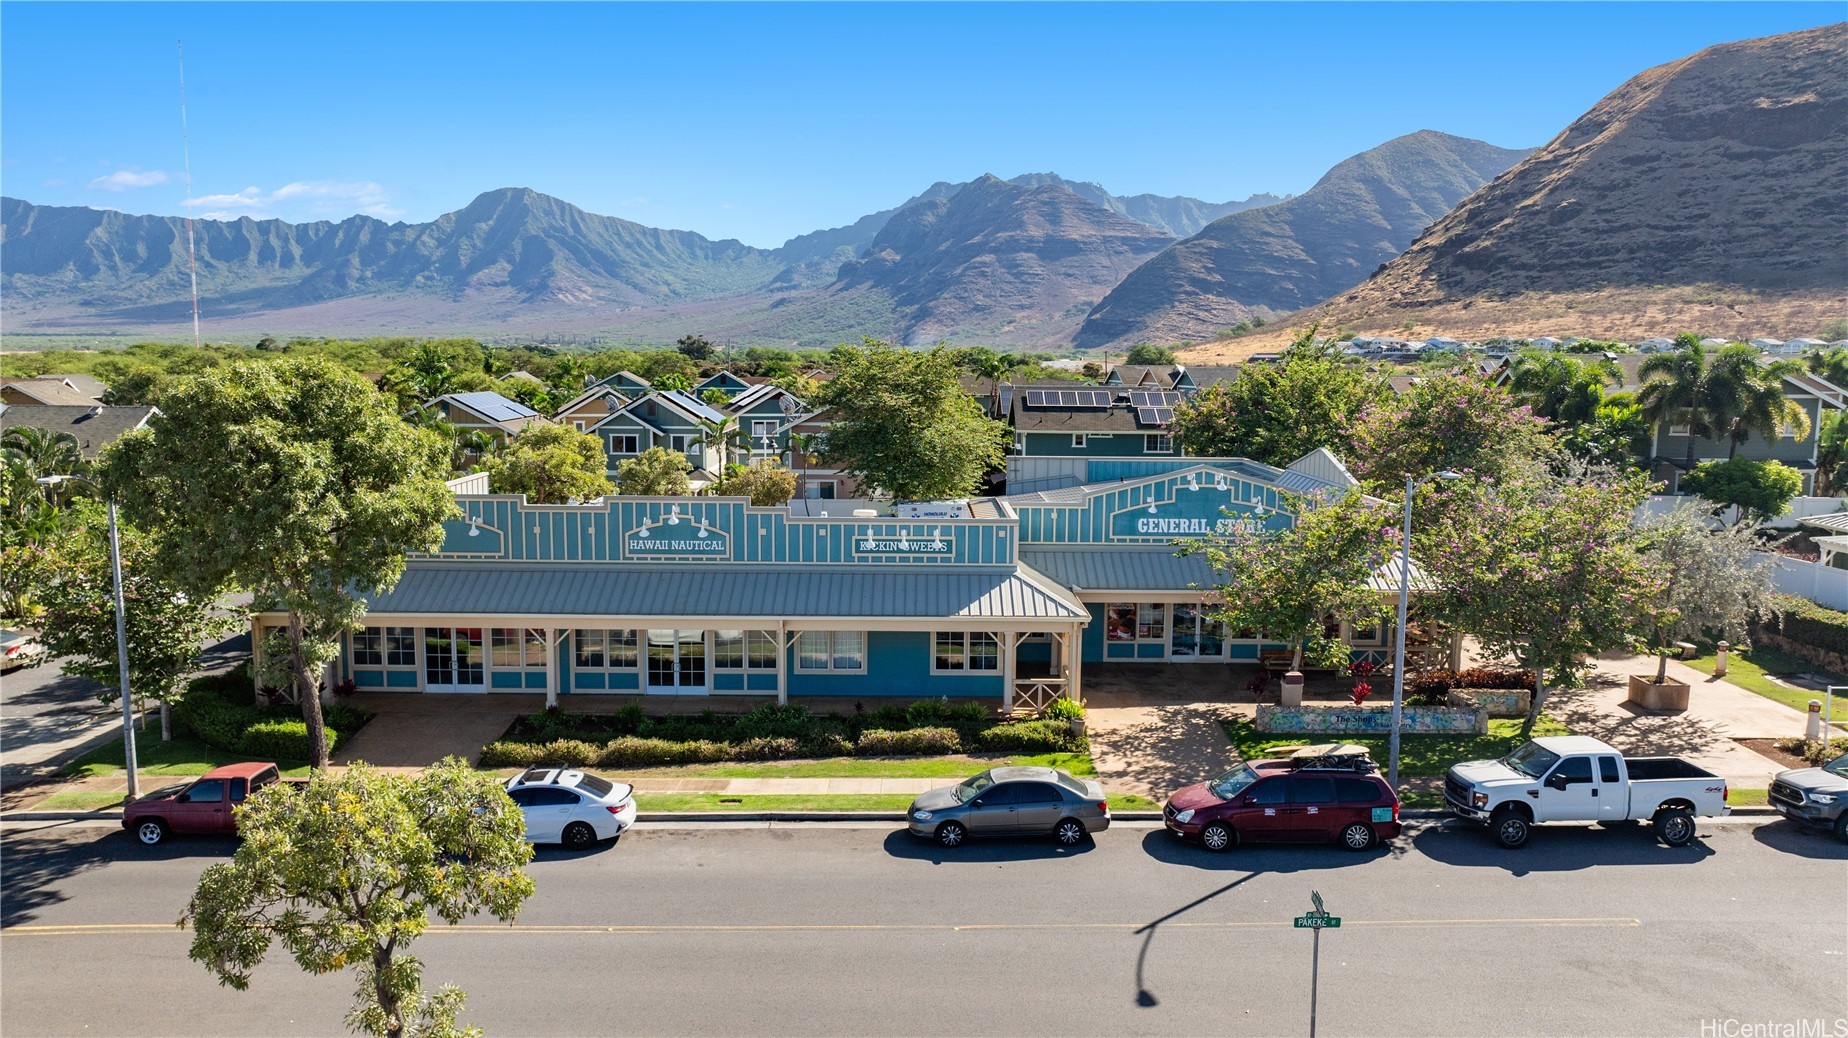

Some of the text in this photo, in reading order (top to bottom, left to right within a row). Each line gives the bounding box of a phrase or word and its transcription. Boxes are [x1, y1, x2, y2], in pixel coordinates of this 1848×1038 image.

[1138, 518, 1210, 533] GENERAL
[630, 540, 724, 550] HAWAII NAUTICAL
[860, 541, 947, 551] KCKIN' WEES
[1353, 716, 1376, 724] Shops
